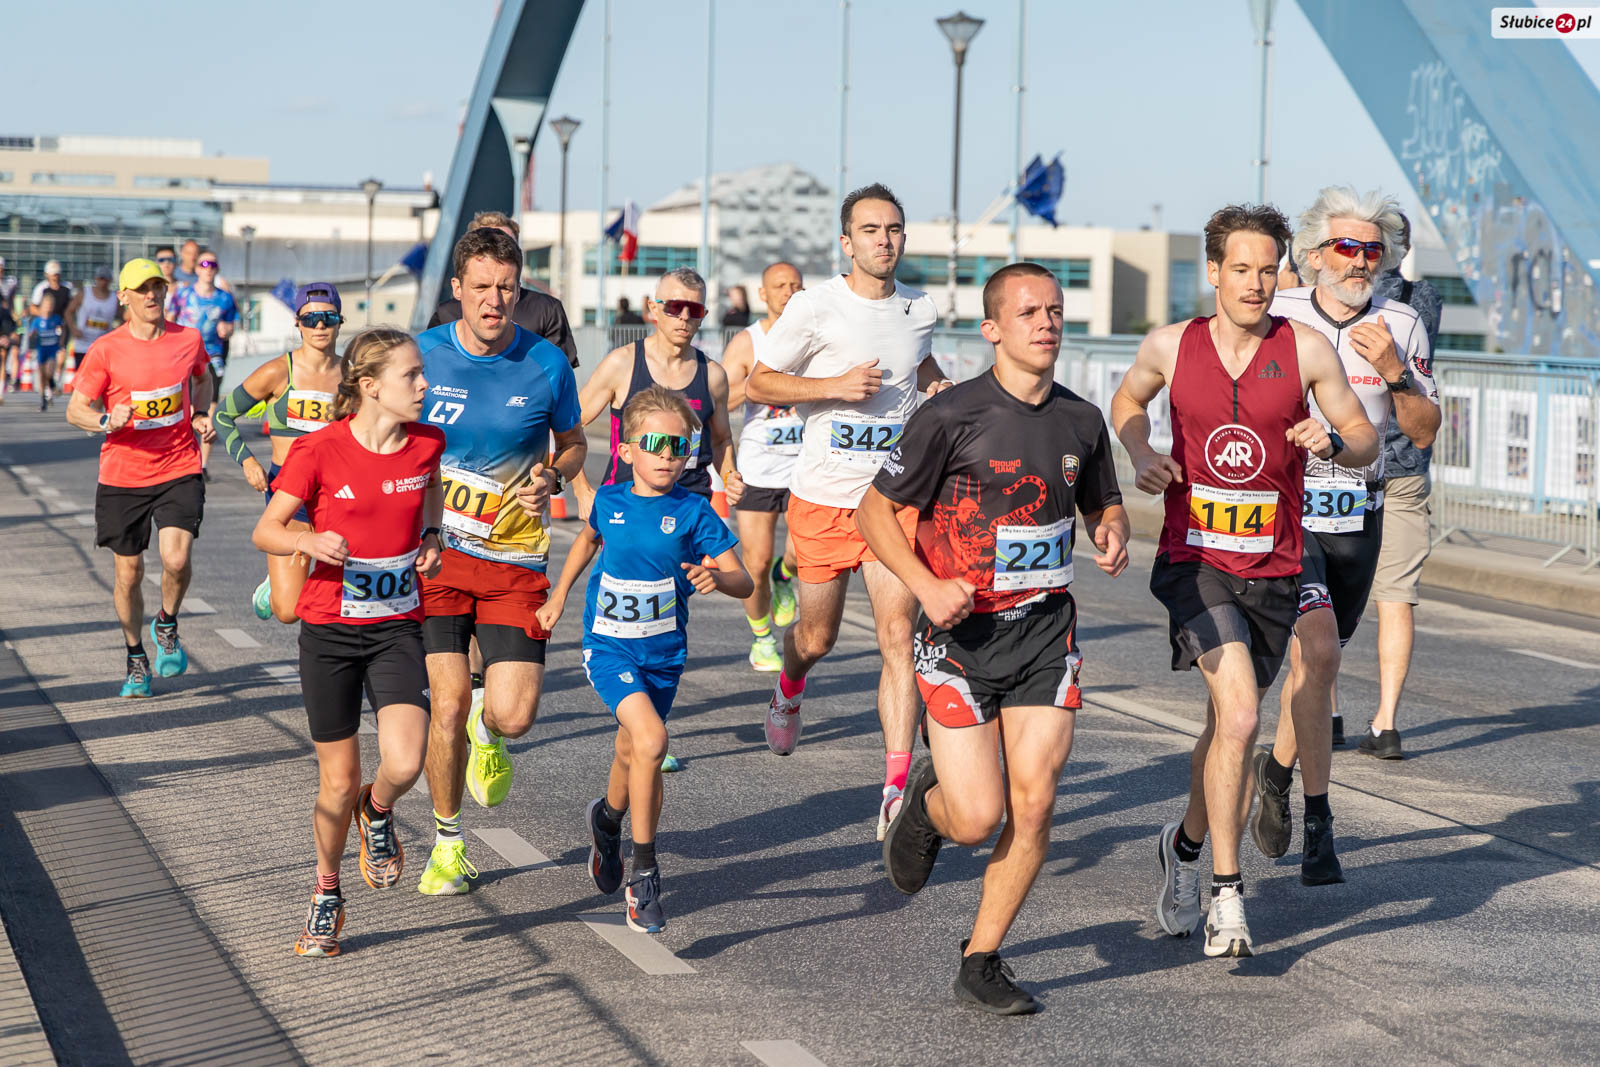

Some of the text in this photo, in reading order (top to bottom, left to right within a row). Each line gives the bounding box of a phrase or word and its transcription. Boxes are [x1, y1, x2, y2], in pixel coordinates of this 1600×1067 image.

[147, 397, 172, 418] 82
[428, 400, 465, 425] 47
[839, 424, 893, 451] 342
[989, 458, 1021, 468] GROUND
[1214, 441, 1254, 468] AR
[994, 466, 1016, 474] GAME
[441, 479, 489, 519] 101
[1202, 502, 1264, 534] 114
[1006, 535, 1065, 572] 221
[353, 568, 412, 601] 308
[603, 591, 660, 622] 231
